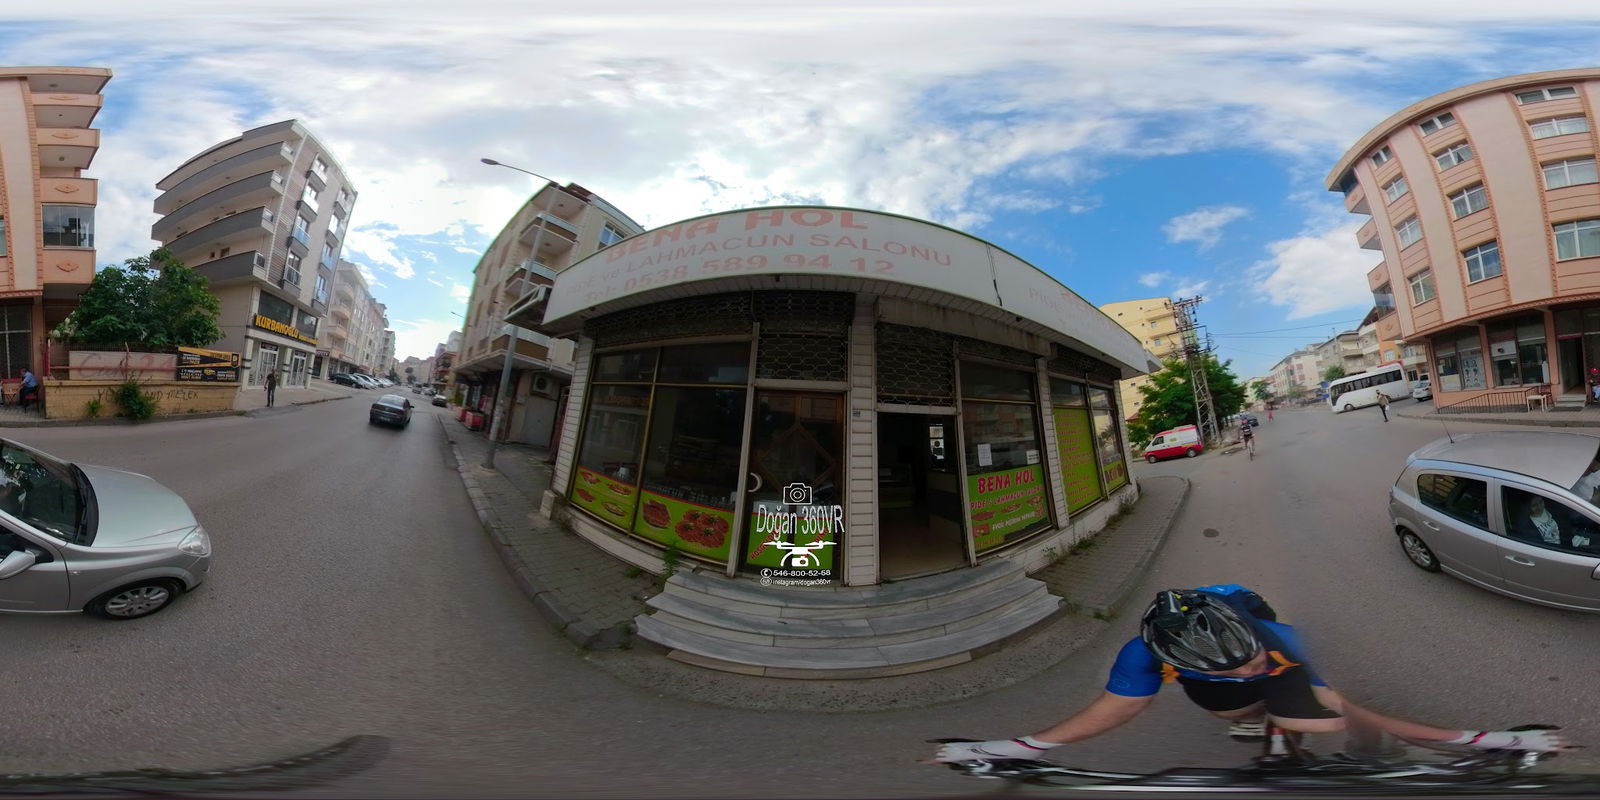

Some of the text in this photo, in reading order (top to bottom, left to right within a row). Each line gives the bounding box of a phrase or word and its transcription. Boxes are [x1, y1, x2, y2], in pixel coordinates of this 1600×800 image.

[602, 268, 620, 281] ve
[626, 233, 795, 273] LAHMACUN
[809, 234, 952, 267] SALONU
[605, 209, 869, 264] BENA HOL
[623, 264, 689, 292] 0538
[702, 255, 768, 274] 589
[783, 254, 832, 269] 94
[850, 257, 896, 275] 12
[977, 473, 1011, 494] BENA
[1014, 469, 1036, 486] HOL
